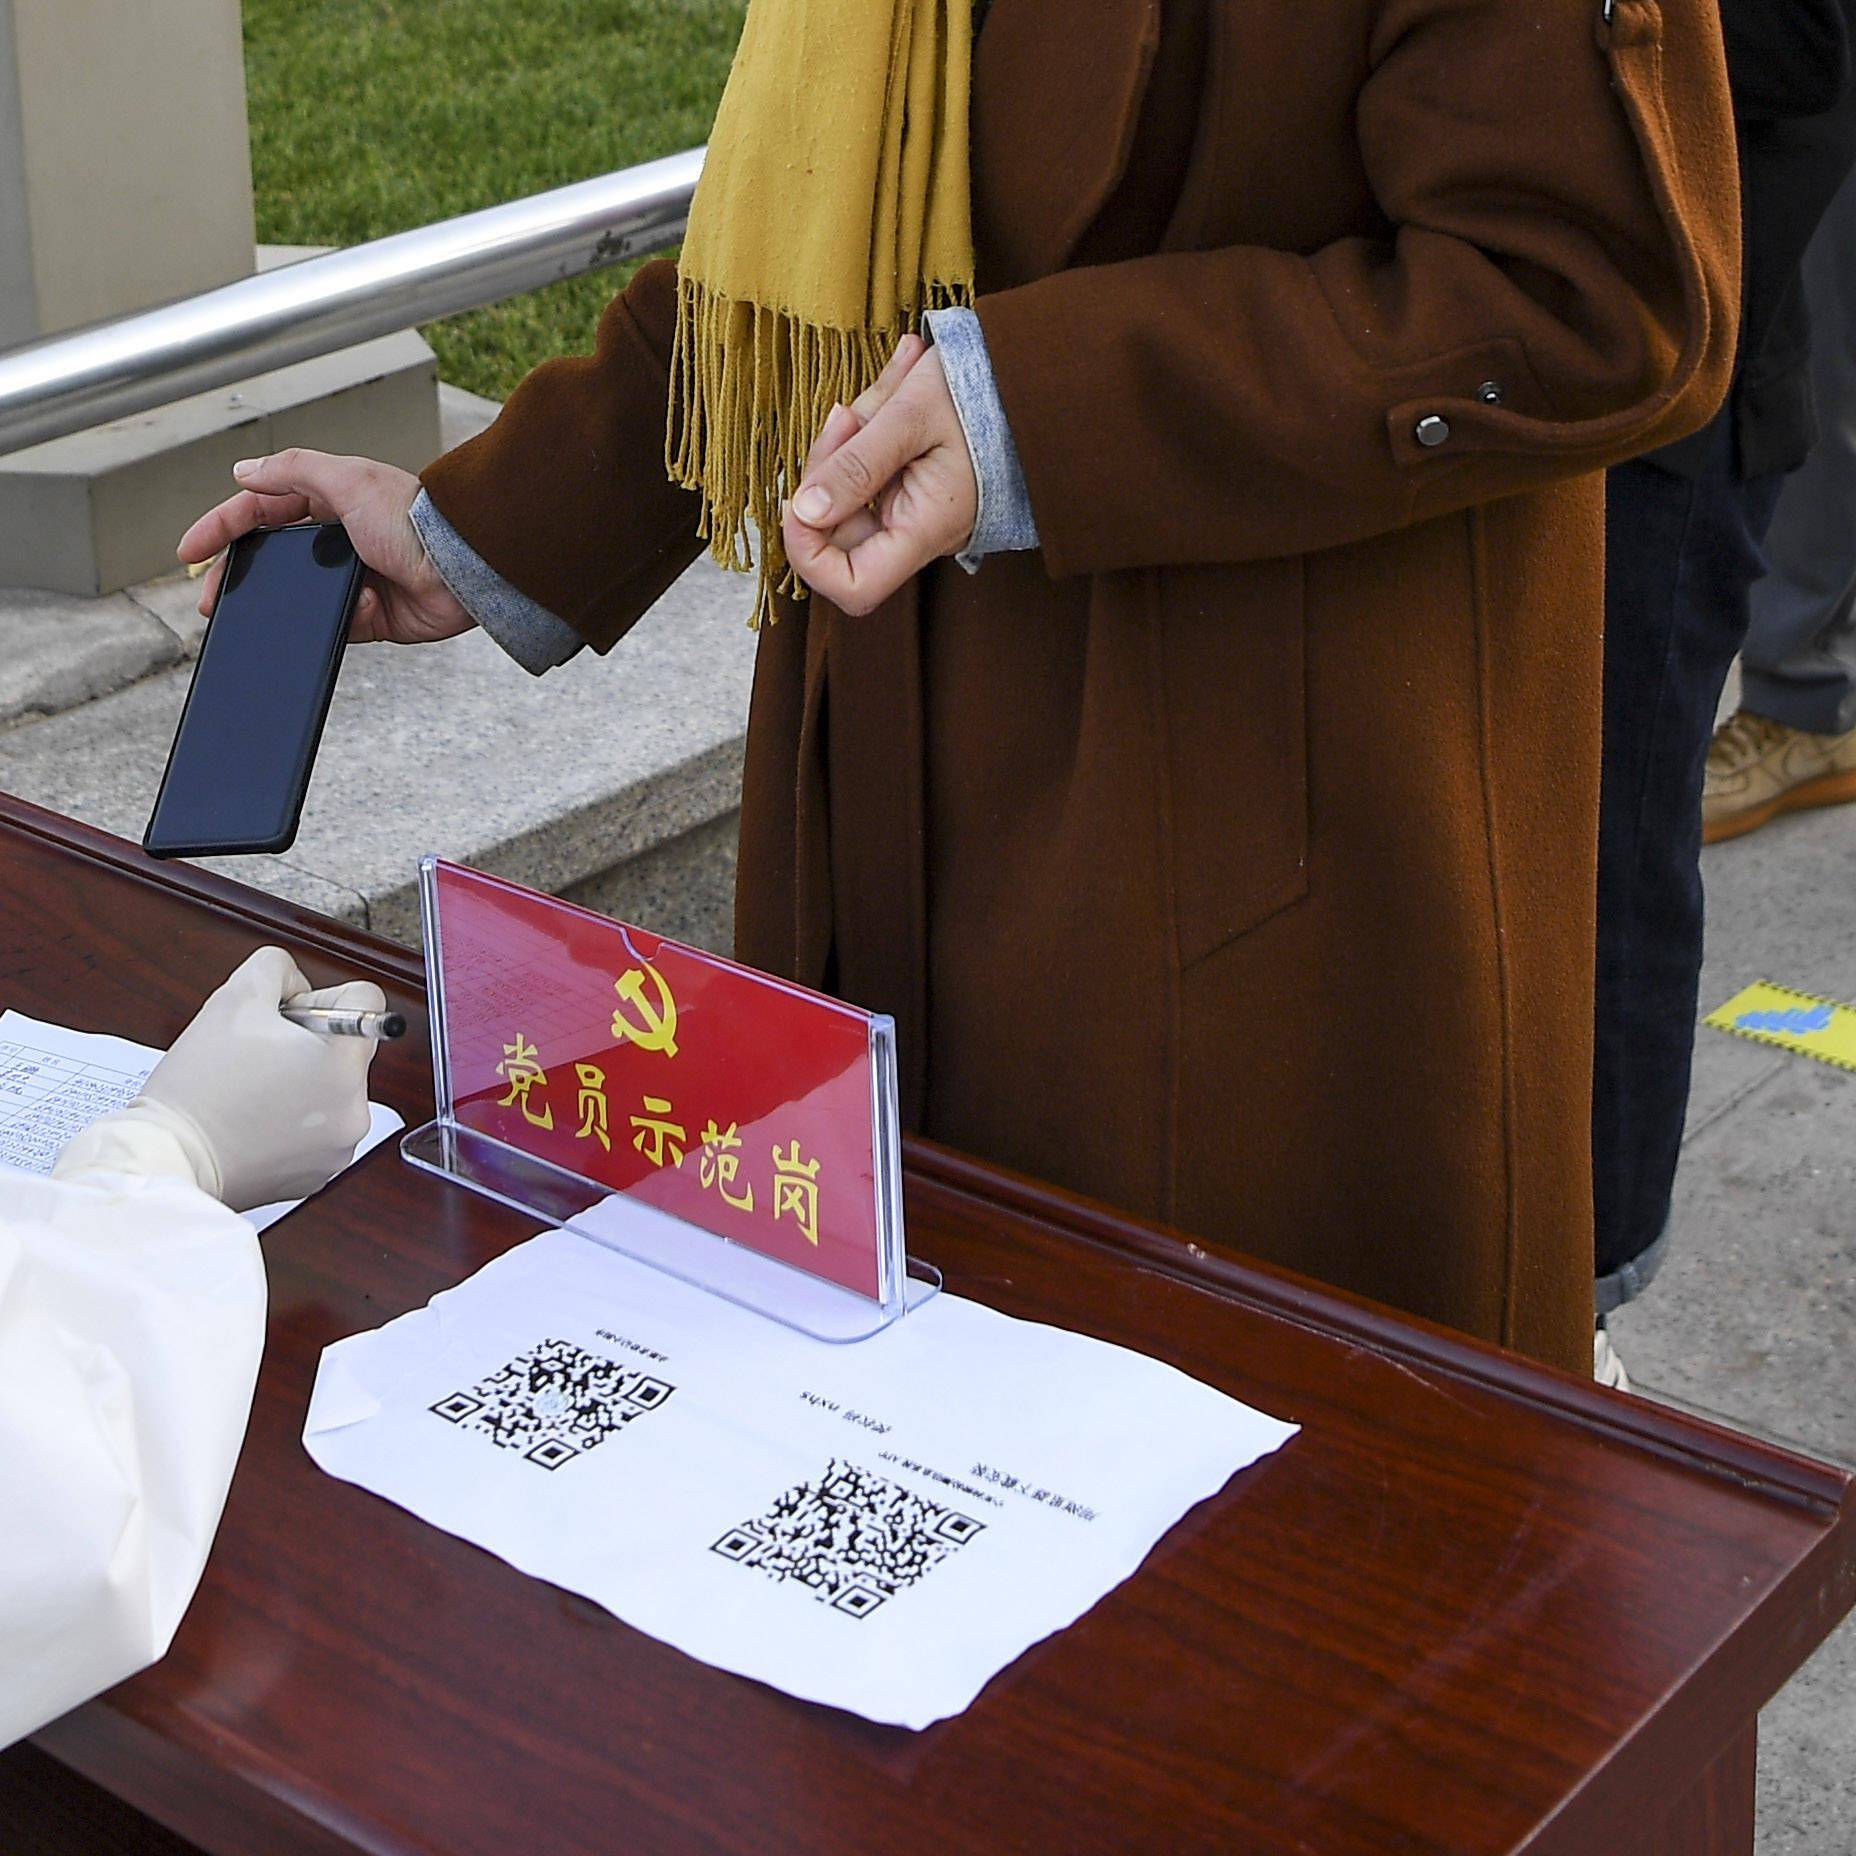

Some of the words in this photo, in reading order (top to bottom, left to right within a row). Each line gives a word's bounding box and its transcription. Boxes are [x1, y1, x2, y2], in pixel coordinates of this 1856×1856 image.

[495, 1032, 821, 1247] 党员示范岗
